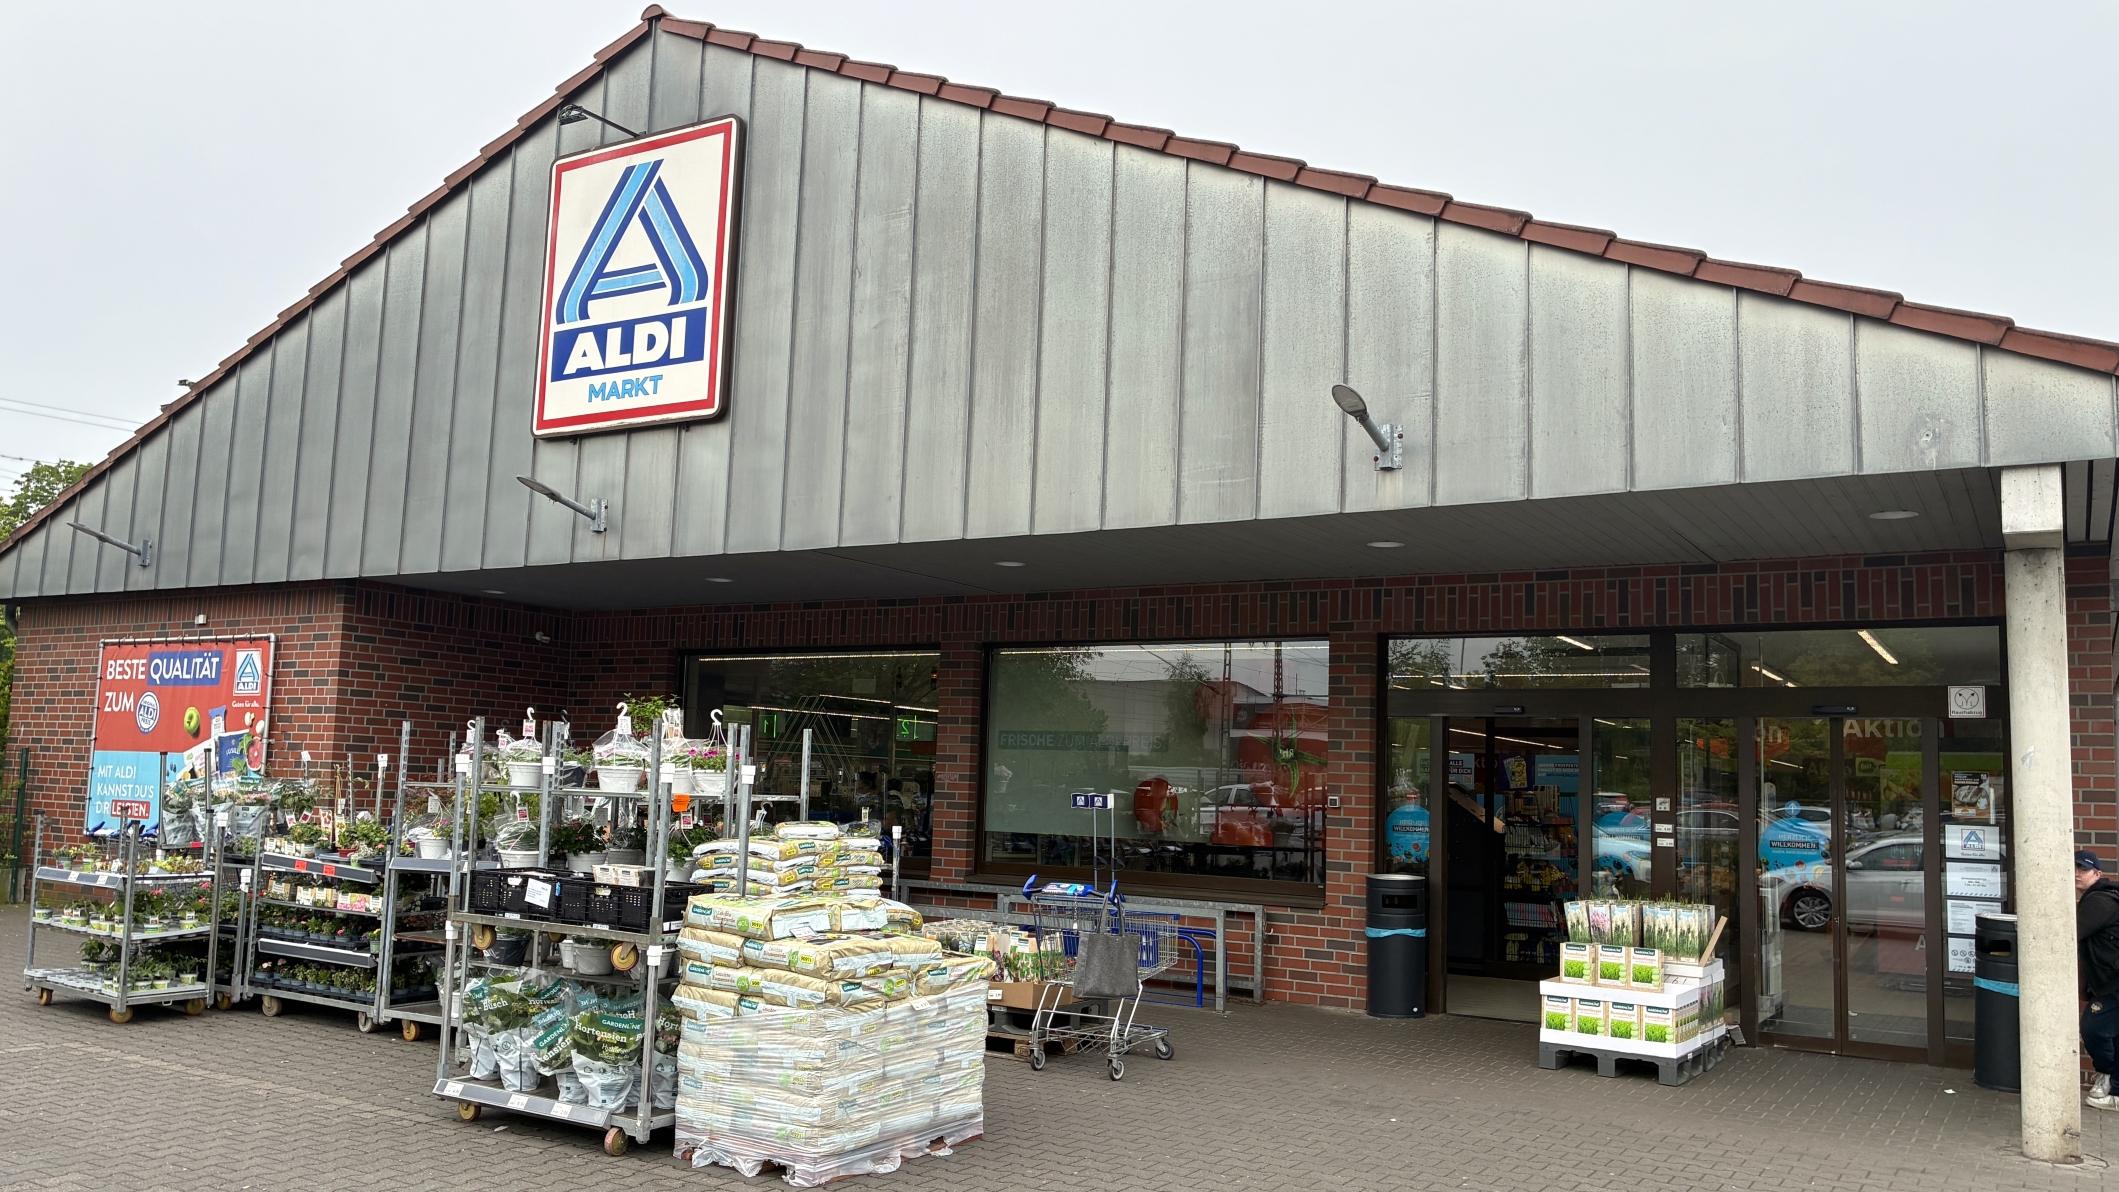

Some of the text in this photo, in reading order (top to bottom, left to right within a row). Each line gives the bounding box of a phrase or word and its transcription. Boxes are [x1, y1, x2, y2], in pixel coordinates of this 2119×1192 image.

[563, 316, 687, 375] ALDI
[588, 374, 663, 403] MARKT
[106, 652, 220, 685] BESTE QUALITÄT
[237, 682, 257, 691] ALDI
[104, 691, 135, 713] ZUM
[139, 704, 157, 722] ALDI
[97, 764, 137, 779] MIT ALDI
[96, 782, 154, 799] KANNST DU'S
[1771, 841, 1818, 849] WILLKOMMEN.
[483, 998, 509, 1011] Busch
[575, 1021, 628, 1043] Hortensien
